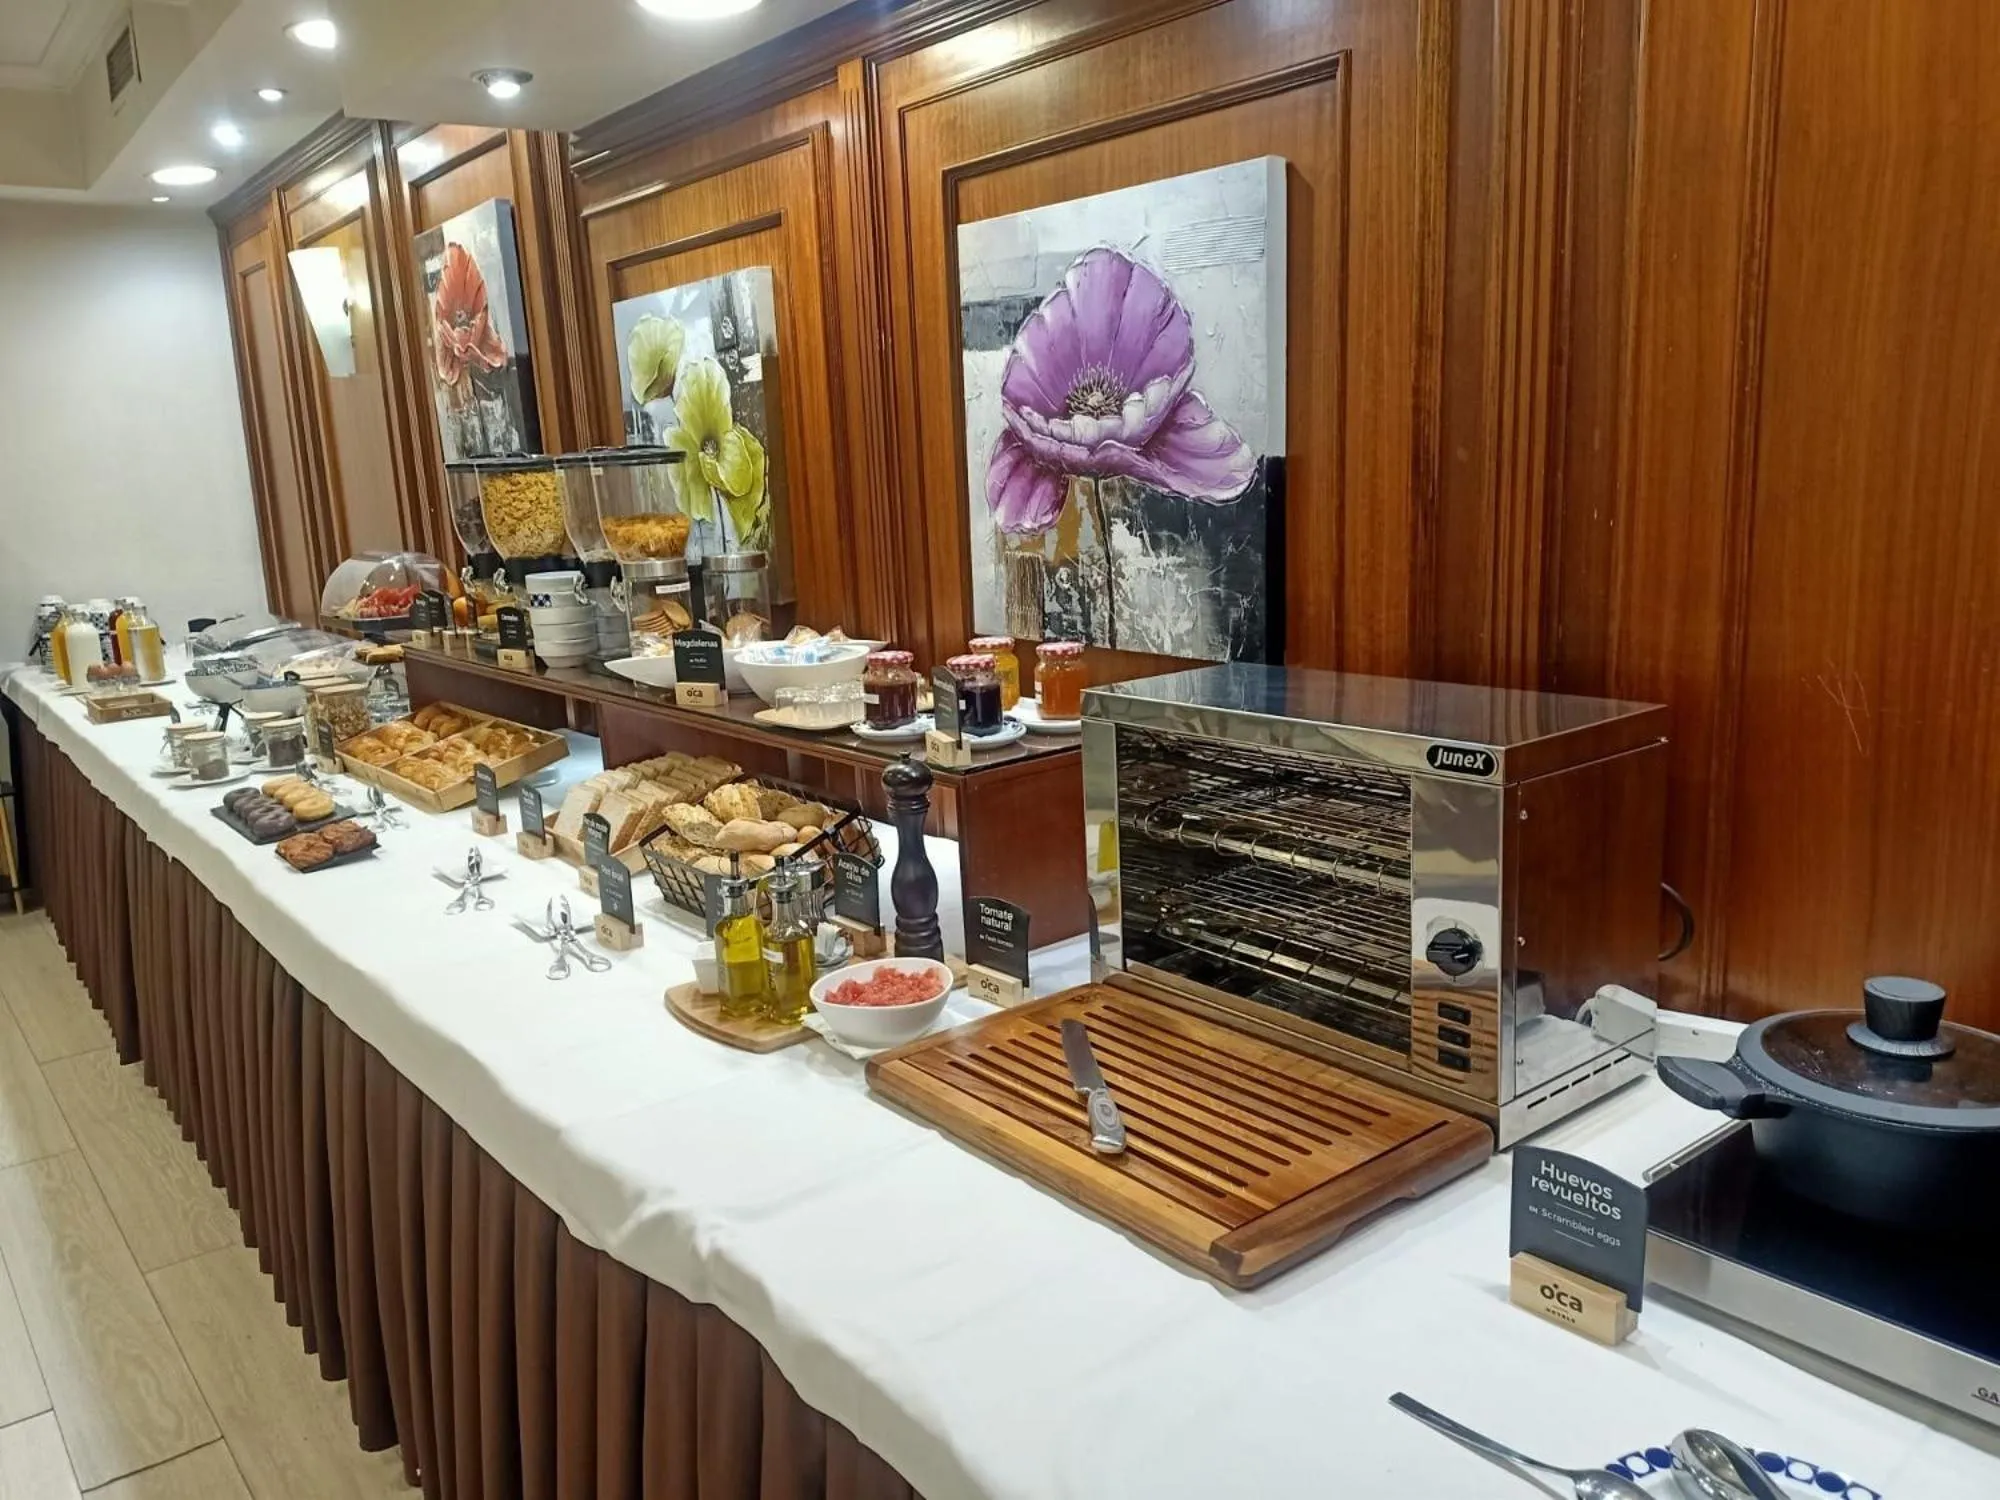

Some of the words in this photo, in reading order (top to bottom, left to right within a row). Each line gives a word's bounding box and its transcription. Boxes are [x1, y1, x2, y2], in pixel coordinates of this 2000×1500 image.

[674, 639, 718, 648] Magdalenas
[979, 903, 1013, 921] Tomate
[981, 914, 1012, 931] natural
[1540, 1159, 1613, 1200] Huevos
[1531, 1174, 1622, 1221] revueltos
[1541, 1207, 1595, 1236] Scrambled
[1597, 1232, 1621, 1247] eggs
